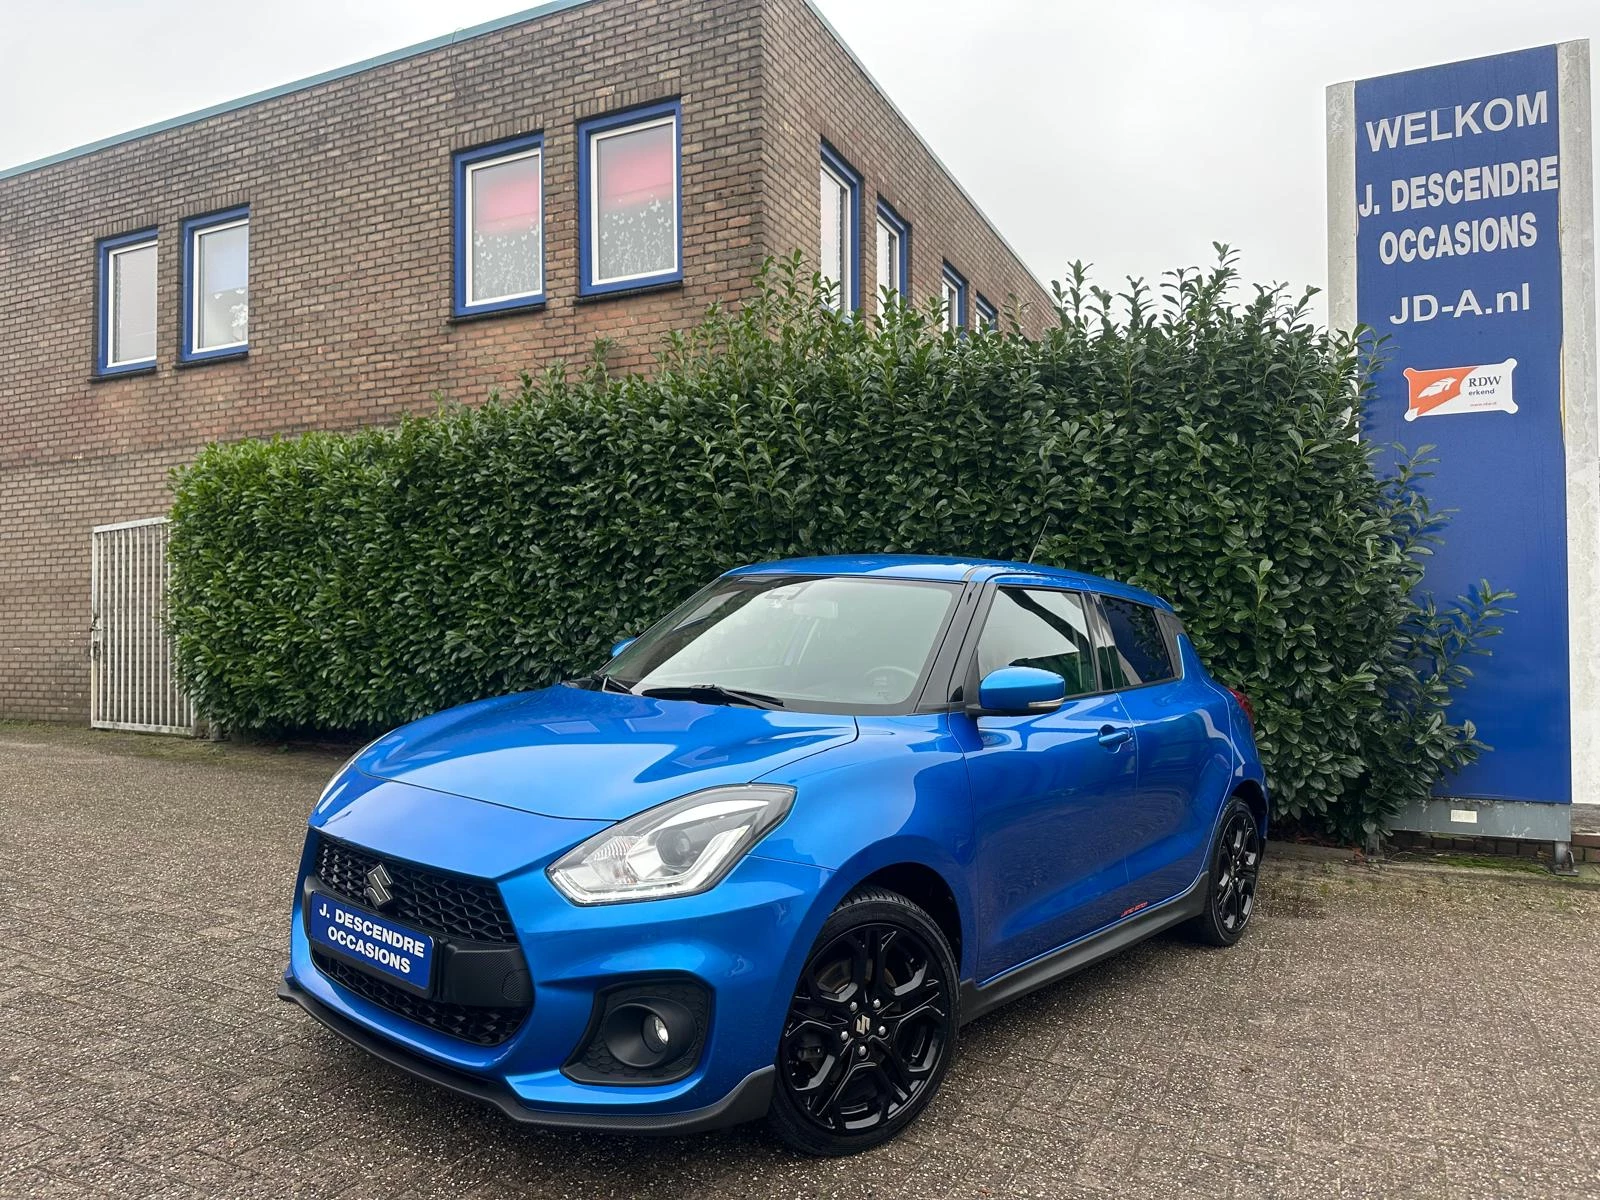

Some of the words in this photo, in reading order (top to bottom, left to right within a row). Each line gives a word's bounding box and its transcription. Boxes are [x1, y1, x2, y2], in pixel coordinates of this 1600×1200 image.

[1365, 90, 1548, 152] WELKOM
[1358, 184, 1380, 218] J.
[1391, 155, 1559, 212] DESCENDRE
[1379, 211, 1538, 265] OCCASIONS
[1389, 282, 1530, 325] JD-A.nl
[1468, 375, 1501, 388] RDW
[1468, 388, 1495, 396] erkend
[319, 903, 330, 919] J.
[335, 908, 425, 958] DESCENDRE
[327, 926, 411, 974] OCCASIONS
